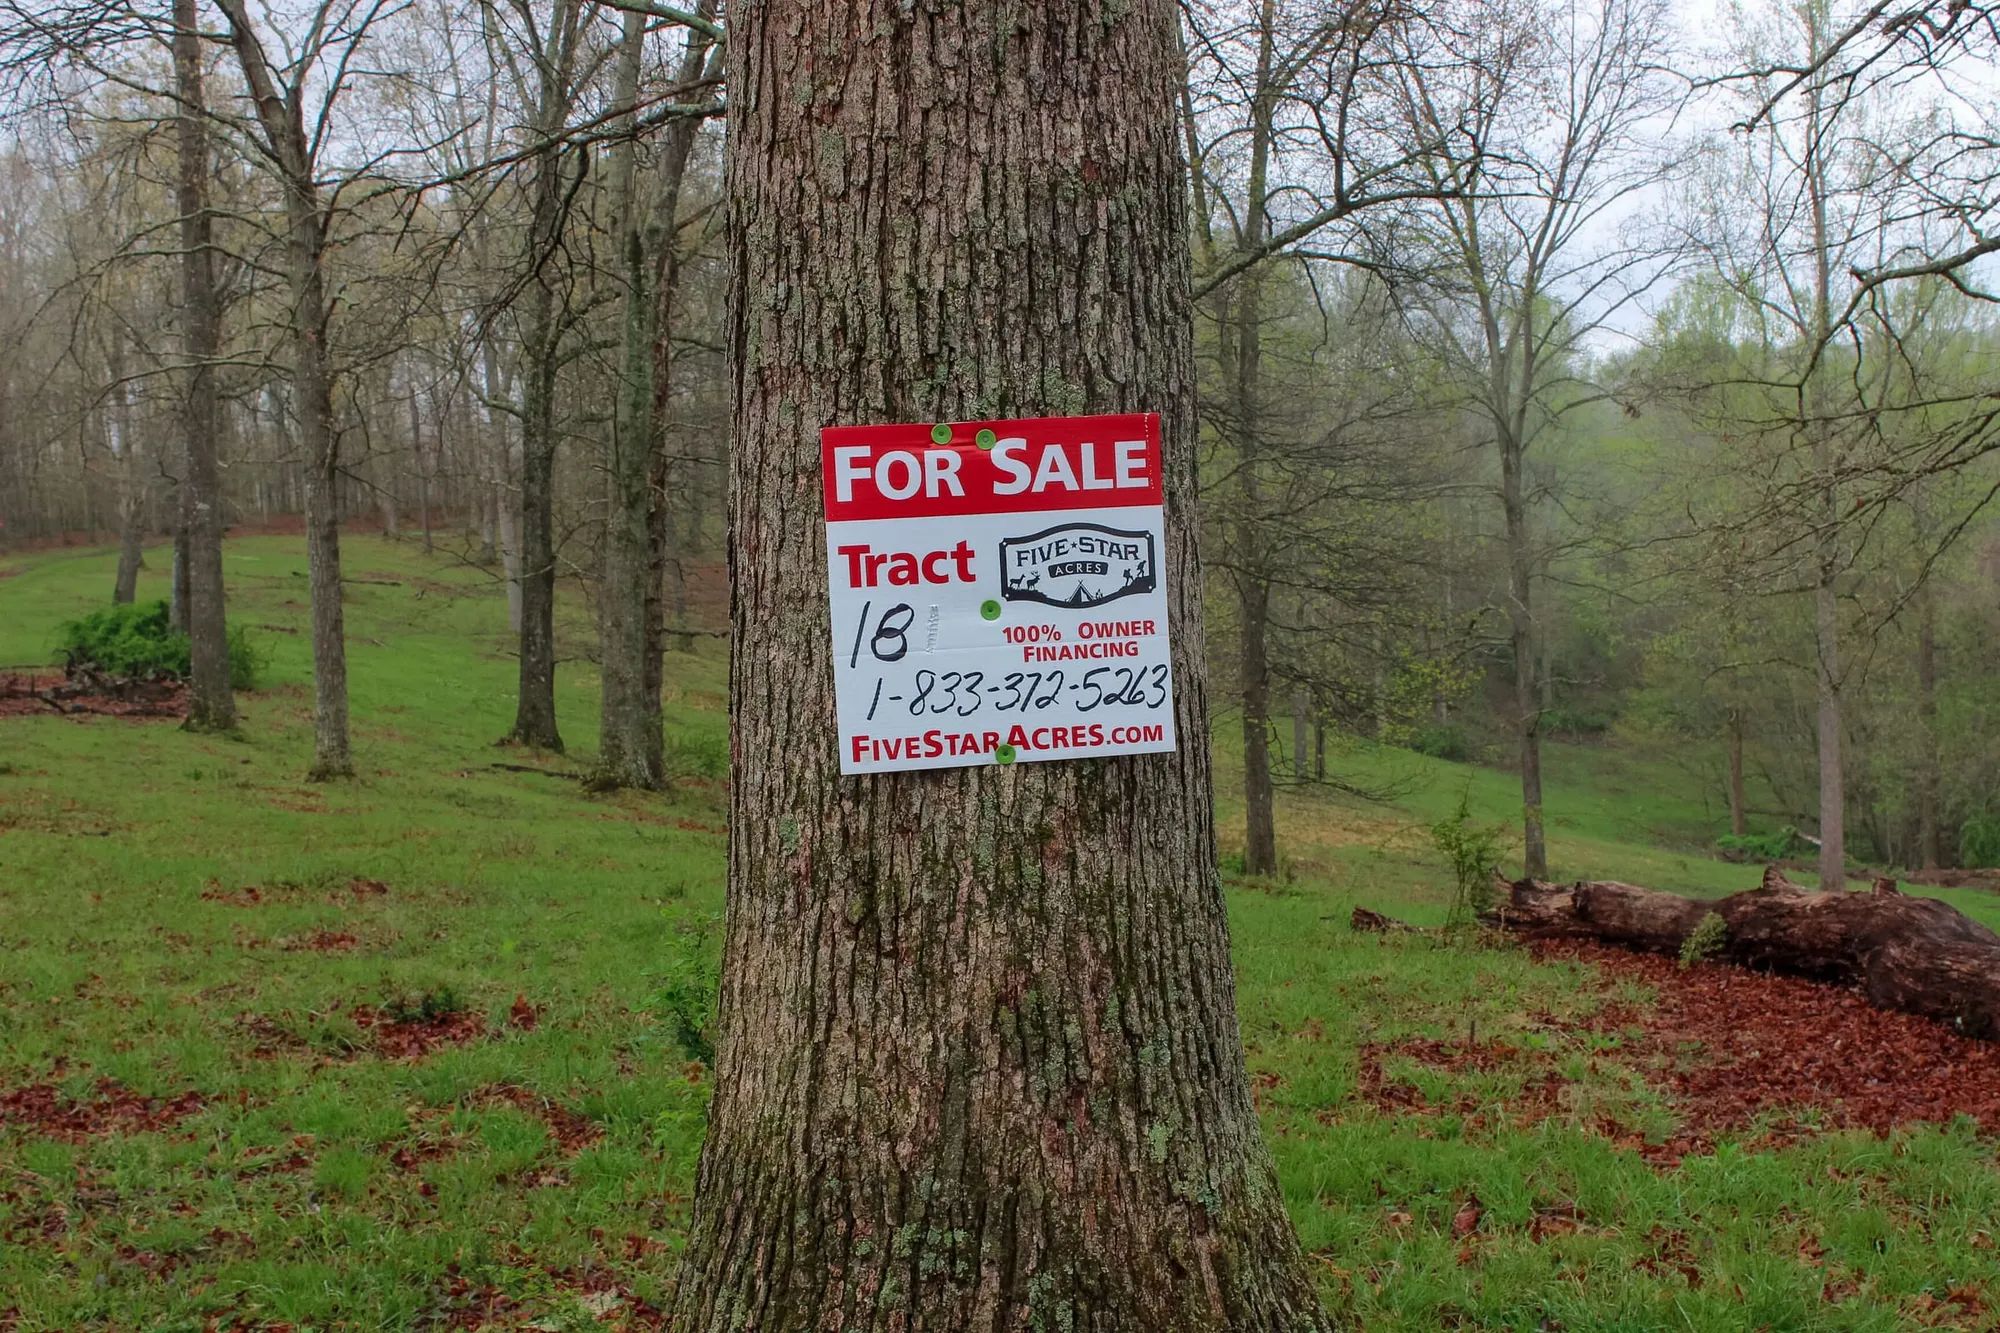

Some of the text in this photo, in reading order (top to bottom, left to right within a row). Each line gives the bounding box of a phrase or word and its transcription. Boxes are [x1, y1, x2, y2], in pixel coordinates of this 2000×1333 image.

[834, 438, 1149, 502] FOR SALE
[837, 540, 976, 588] Tract
[1016, 536, 1140, 567] FIVE STAR
[1055, 562, 1102, 576] ACRES
[850, 601, 915, 668] 18
[1002, 620, 1156, 643] 100% OWNER
[1023, 641, 1140, 662] FINANCING
[866, 664, 1167, 720] 1-833-372-5263
